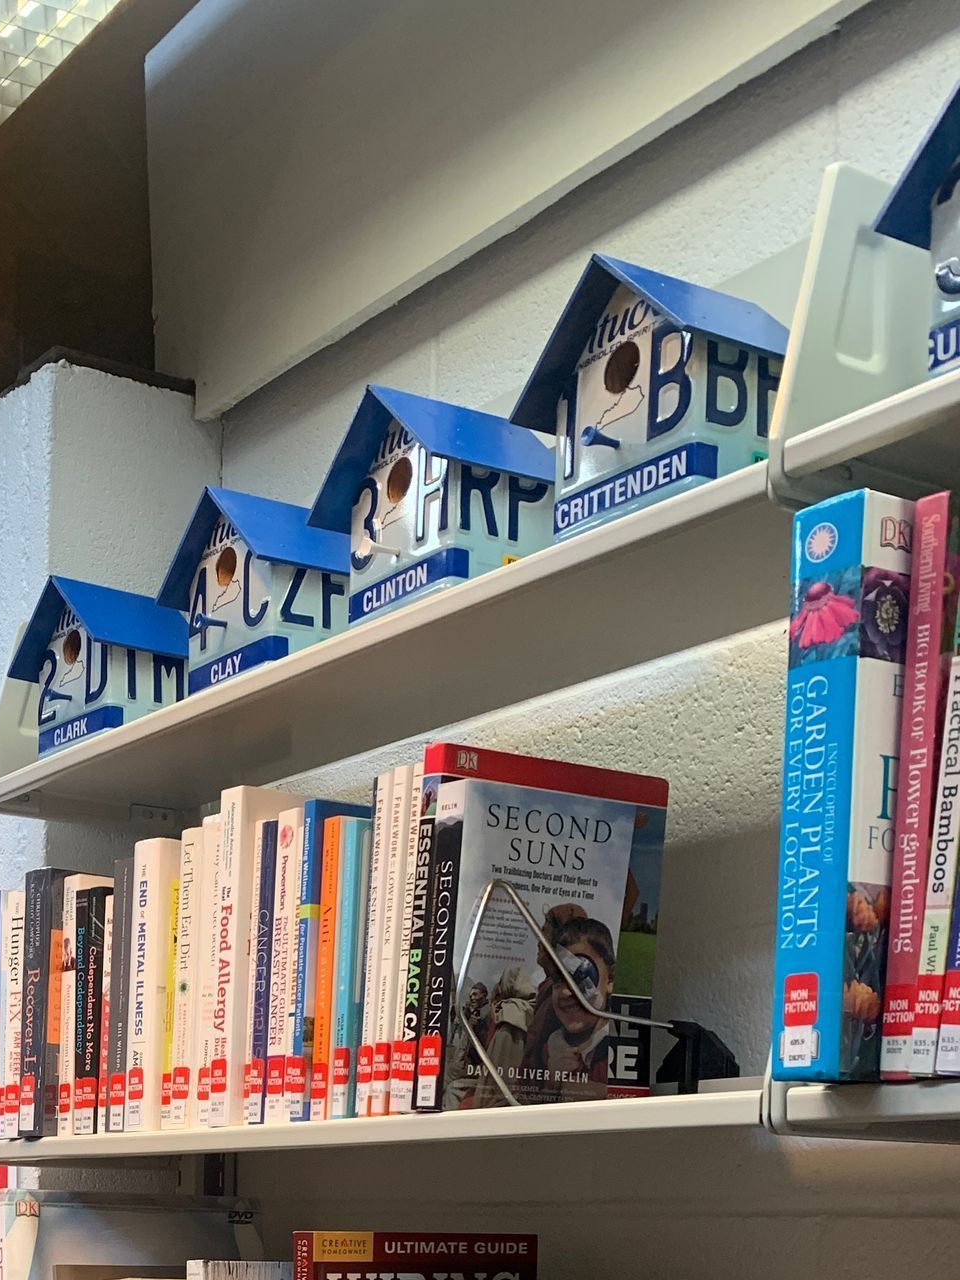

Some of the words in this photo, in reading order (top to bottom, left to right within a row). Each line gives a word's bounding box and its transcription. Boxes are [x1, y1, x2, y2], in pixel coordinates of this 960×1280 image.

[555, 450, 687, 531] CRITTENDEN
[362, 563, 428, 614] CLINTON
[210, 652, 242, 684] CLAY
[915, 624, 931, 657] BIG
[789, 683, 805, 727] FOR
[912, 663, 929, 712] BOOK
[53, 717, 88, 746] CLARK
[802, 675, 828, 815] GARDEN
[910, 716, 926, 741] OF
[785, 740, 802, 819] EVERY
[904, 748, 928, 829] Flower
[487, 803, 612, 844] SECOND
[932, 785, 958, 894] Bamboos
[508, 837, 586, 871] SUNS
[410, 823, 432, 944] ESSENTIAL
[780, 824, 799, 950] LOCATION
[796, 825, 822, 949] PLANTS
[892, 833, 921, 954] gardening
[218, 904, 233, 953] Food
[433, 860, 453, 967] SECOND
[7, 916, 24, 986] Hunger
[137, 922, 147, 978] MENTAL
[270, 917, 283, 980] BREAST
[213, 957, 231, 1032] Allergy
[406, 949, 423, 1008] BACK
[790, 989, 808, 1001] NON
[75, 971, 85, 1056] Codependency
[134, 981, 144, 1036] ILLNESS
[268, 982, 280, 1046] CANCER
[784, 1000, 816, 1014] FICTION
[508, 1066, 550, 1081] OLIVER
[554, 1070, 589, 1083] RELIN
[322, 1238, 367, 1248] CREATIVE
[385, 1241, 468, 1254] ULTIMATE
[474, 1242, 528, 1254] GUIDE
